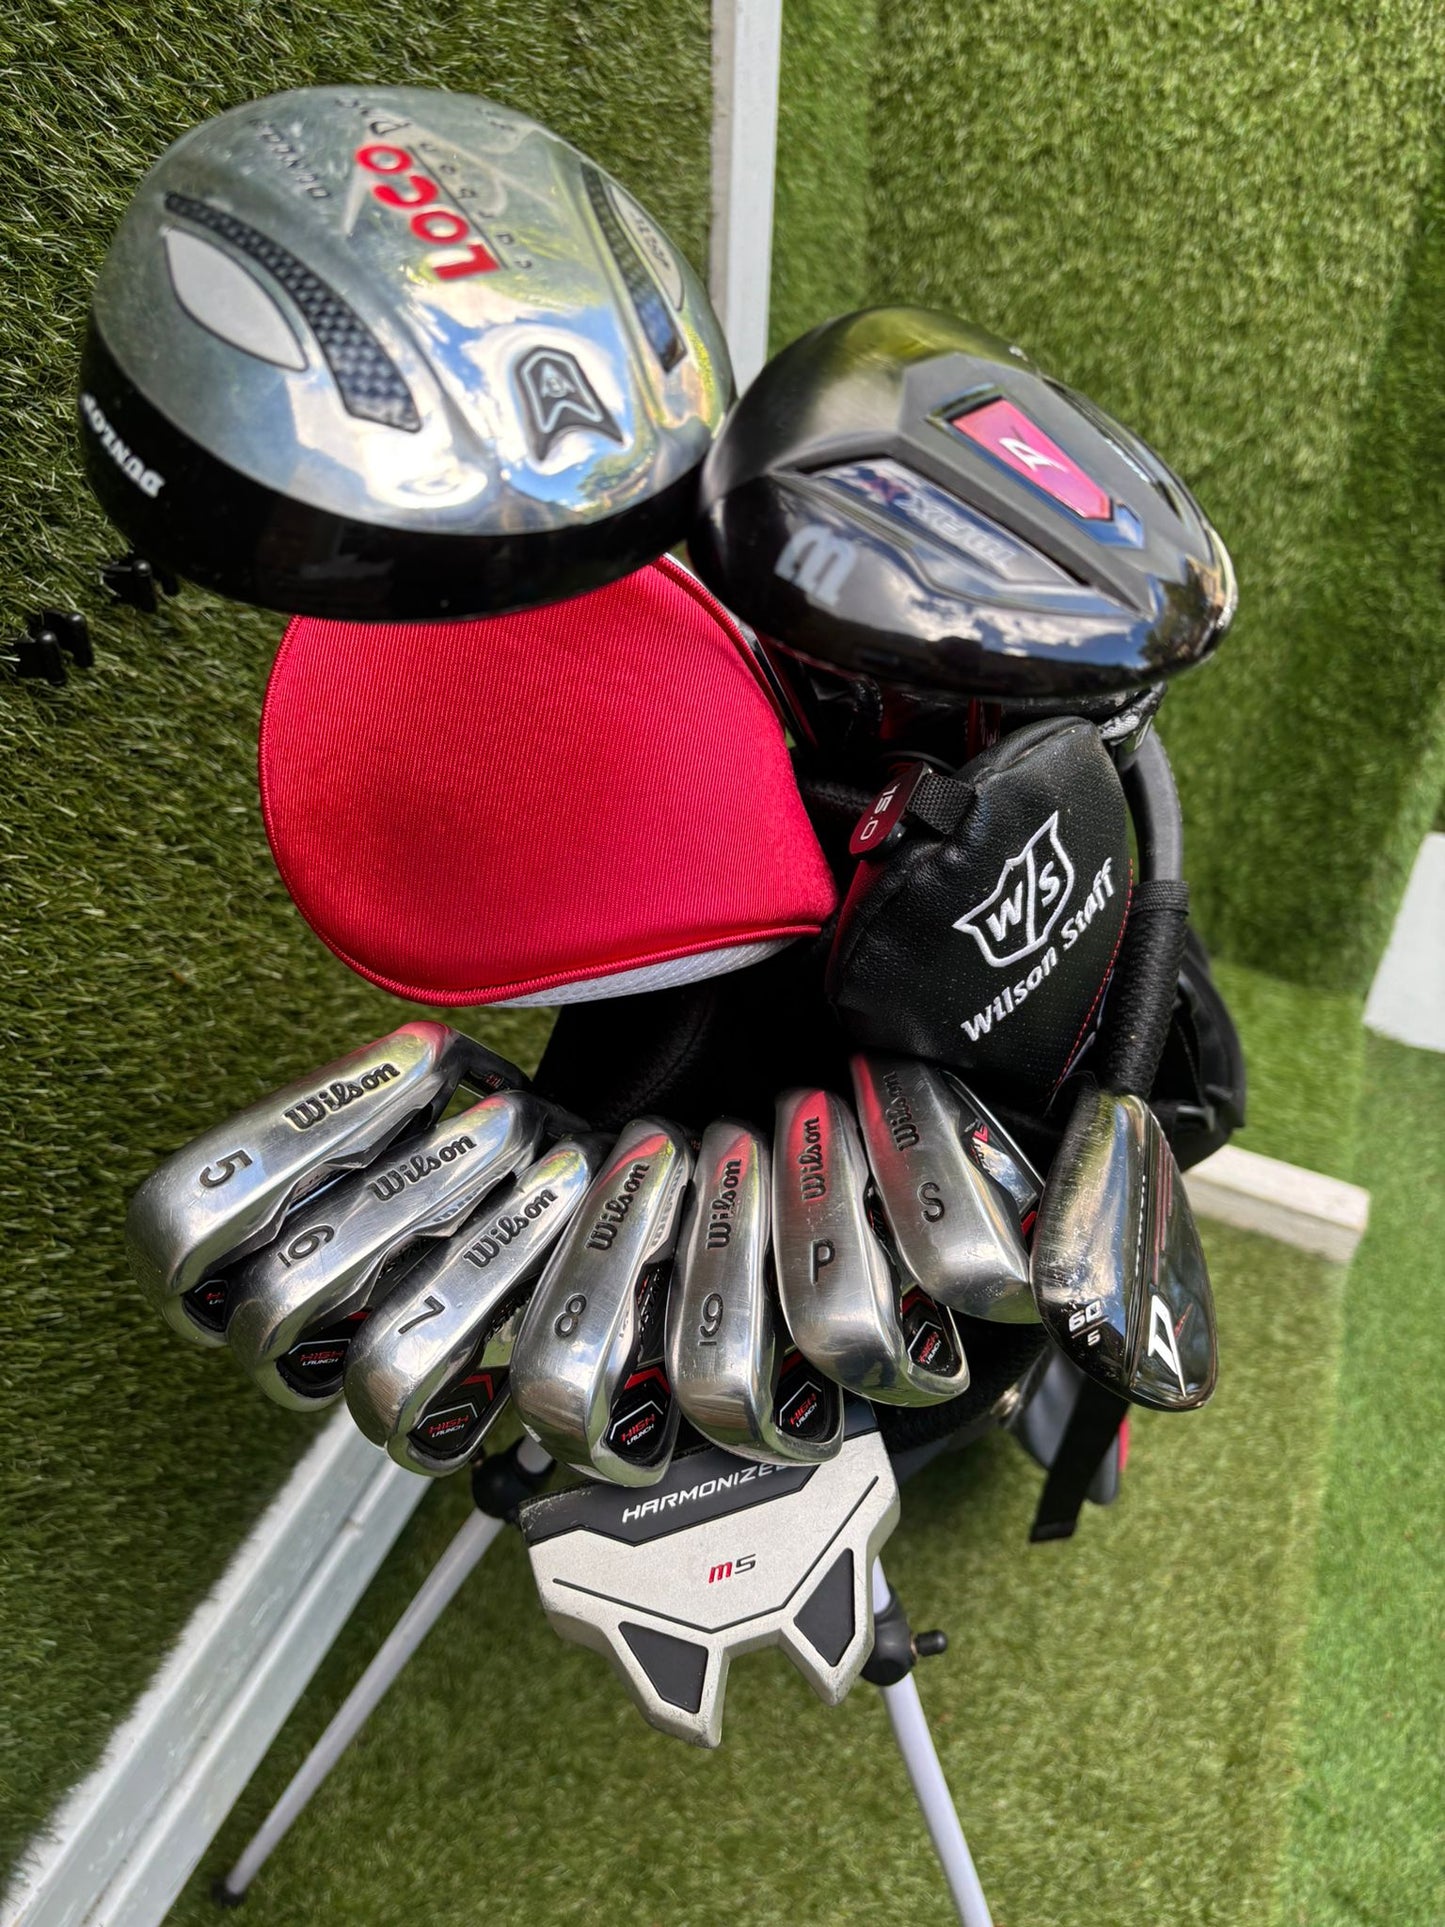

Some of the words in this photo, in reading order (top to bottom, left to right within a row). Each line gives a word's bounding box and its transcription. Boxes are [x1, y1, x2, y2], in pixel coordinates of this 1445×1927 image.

[355, 143, 500, 282] LOCO
[81, 393, 165, 498] DUNLOP
[859, 783, 901, 842] 15.0
[961, 946, 1058, 1042] Wilson
[1061, 857, 1116, 951] Staff
[283, 1061, 401, 1133] Wilson
[882, 1070, 920, 1152] Wilson
[199, 1148, 256, 1189] 5
[368, 1132, 477, 1202] Wilson
[800, 1116, 829, 1201] Wilson
[585, 1161, 650, 1253] Wilson
[705, 1159, 742, 1251] Wilson
[920, 1181, 946, 1223] S
[463, 1187, 559, 1270] Wilson
[811, 1238, 837, 1285] P
[398, 1296, 447, 1335] 7
[554, 1293, 588, 1339] 8
[1067, 1299, 1103, 1332] 60
[300, 1350, 344, 1361] HIGH
[302, 1358, 339, 1367] LAUNCH
[918, 1331, 939, 1363] HIGH
[925, 1339, 941, 1364] LAUNCH
[428, 1415, 469, 1434] HIGH
[432, 1423, 465, 1438] LAUNCH
[621, 1413, 655, 1442] HIGH
[789, 1393, 817, 1426] HIGH
[795, 1402, 817, 1428] LAUNCH
[626, 1423, 655, 1446] LAUNCH
